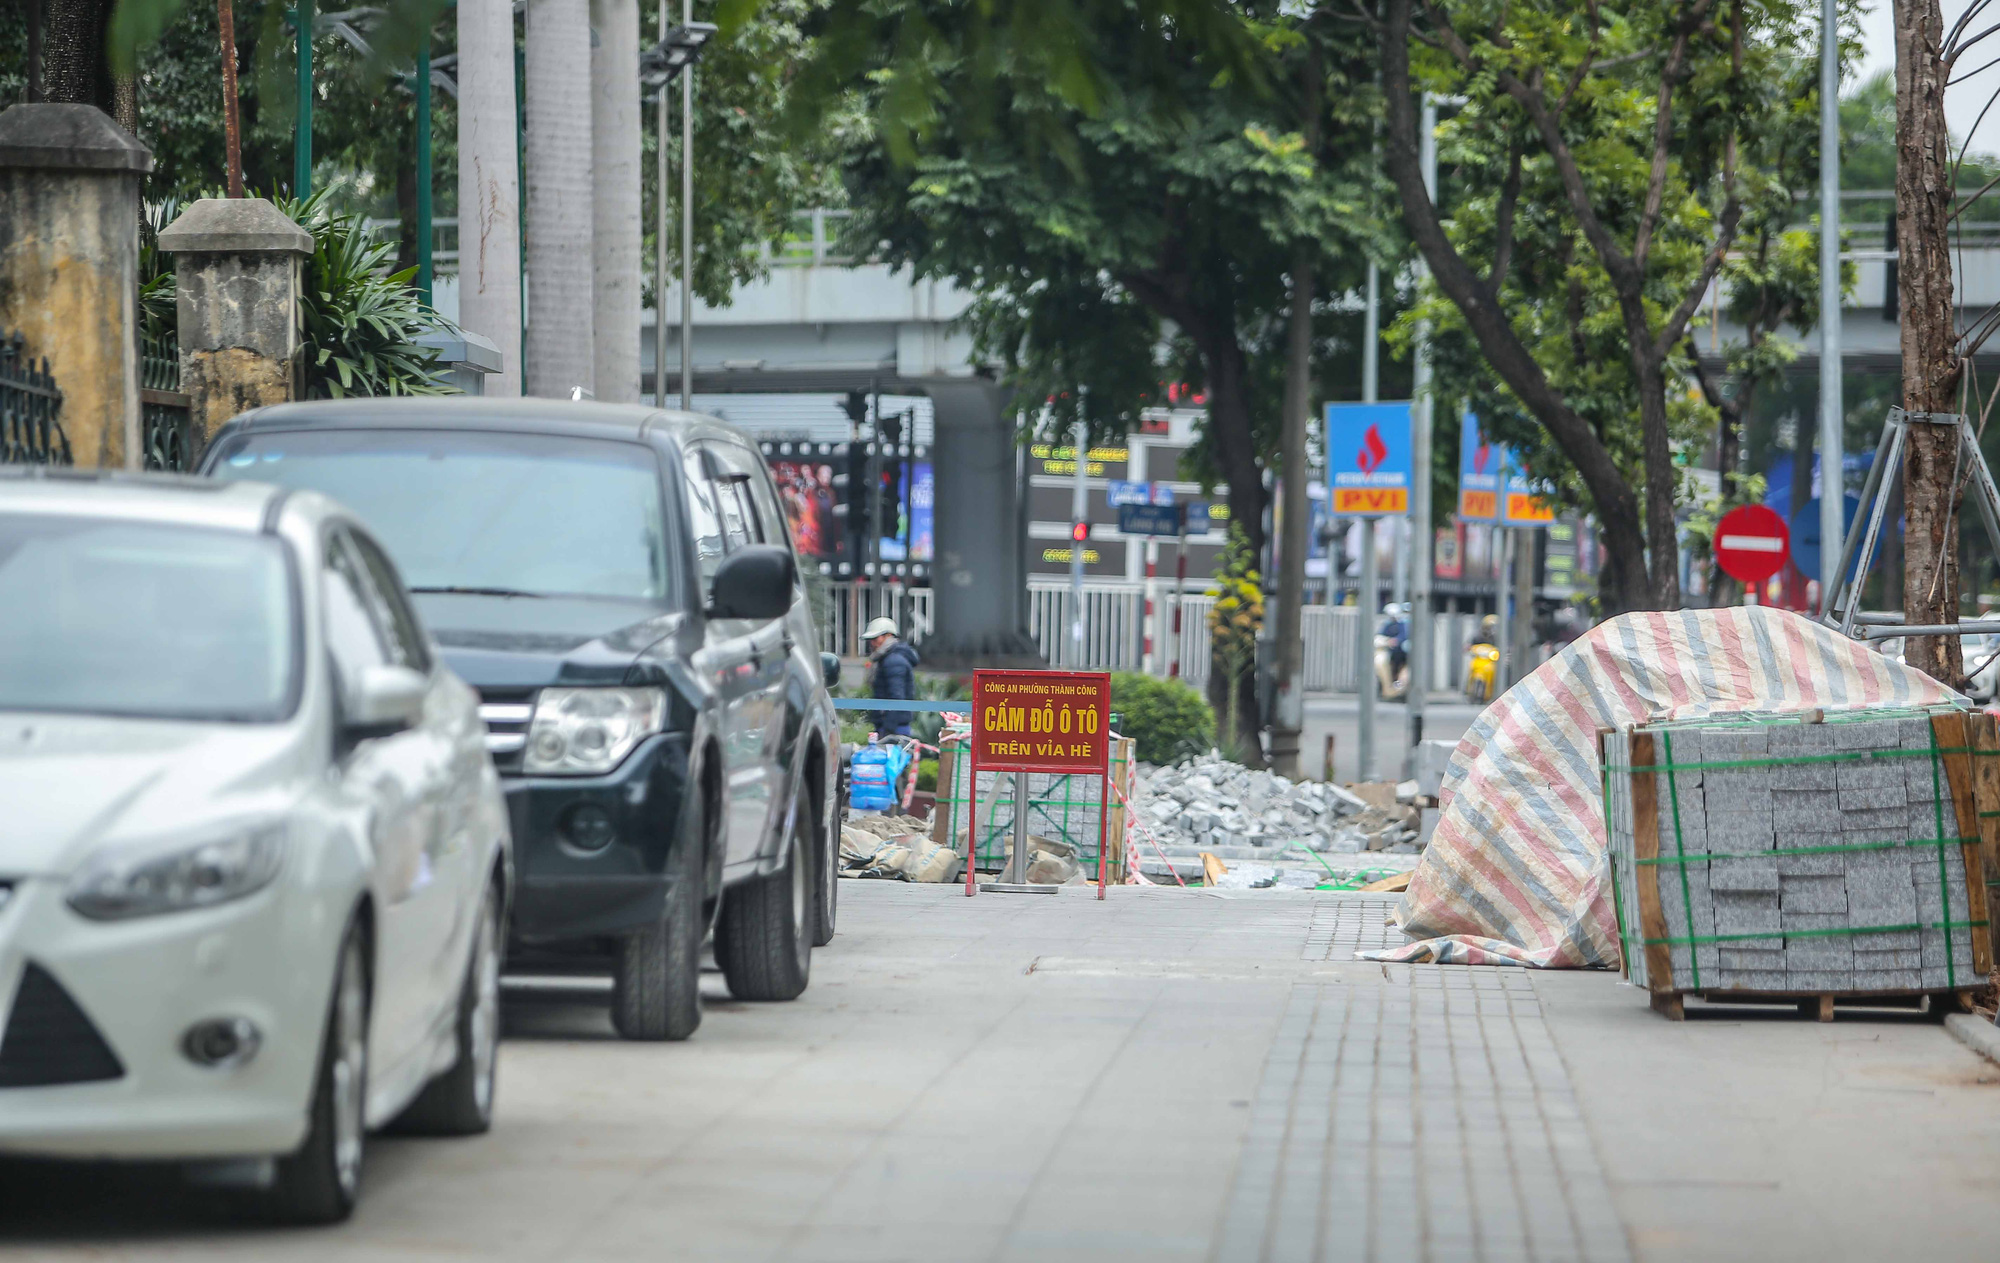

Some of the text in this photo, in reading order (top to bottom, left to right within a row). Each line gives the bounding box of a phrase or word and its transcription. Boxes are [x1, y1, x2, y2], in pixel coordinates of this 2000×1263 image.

[1342, 489, 1398, 507] PVI
[985, 682, 1097, 695] CÔNG AN PHƯỜNG THÀNH CÔNG
[984, 698, 1098, 734] CẤM ĐỖ Ô TÔ
[988, 739, 1092, 757] TRÊN VỈA HÈ
